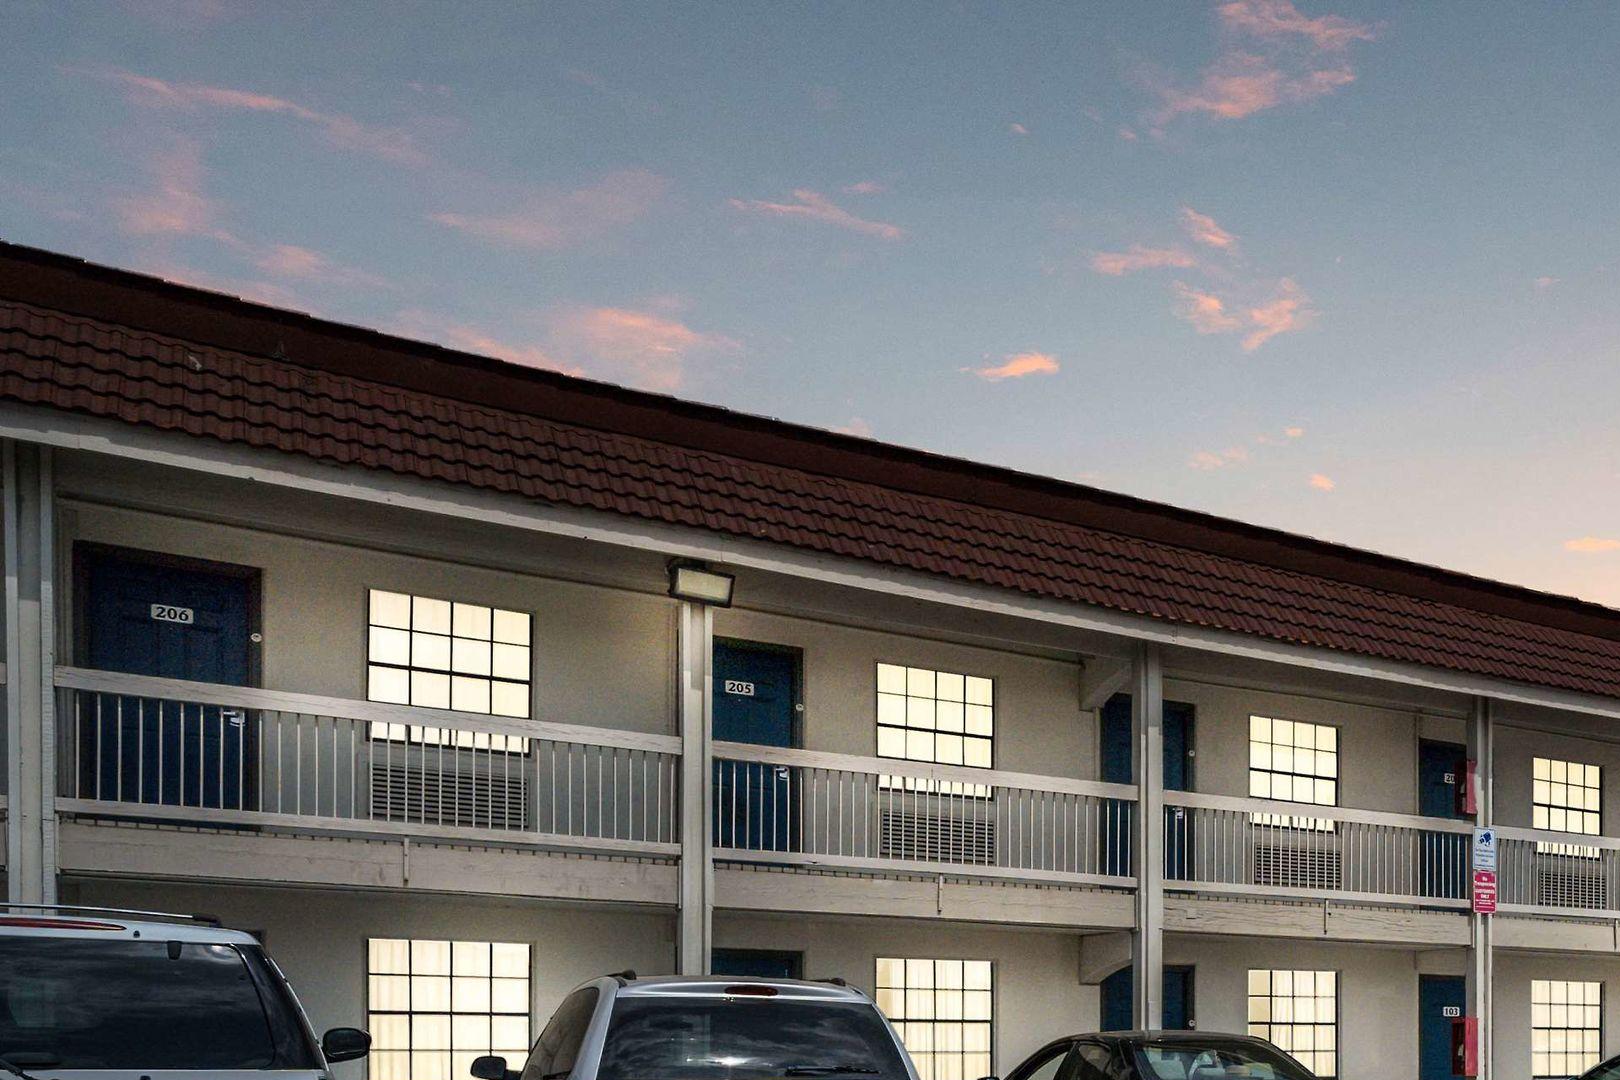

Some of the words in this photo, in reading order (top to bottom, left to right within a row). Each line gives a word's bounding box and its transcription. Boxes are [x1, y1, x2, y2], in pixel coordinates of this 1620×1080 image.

[155, 606, 189, 621] 206
[728, 682, 751, 694] 205
[1444, 1007, 1458, 1015] 103
